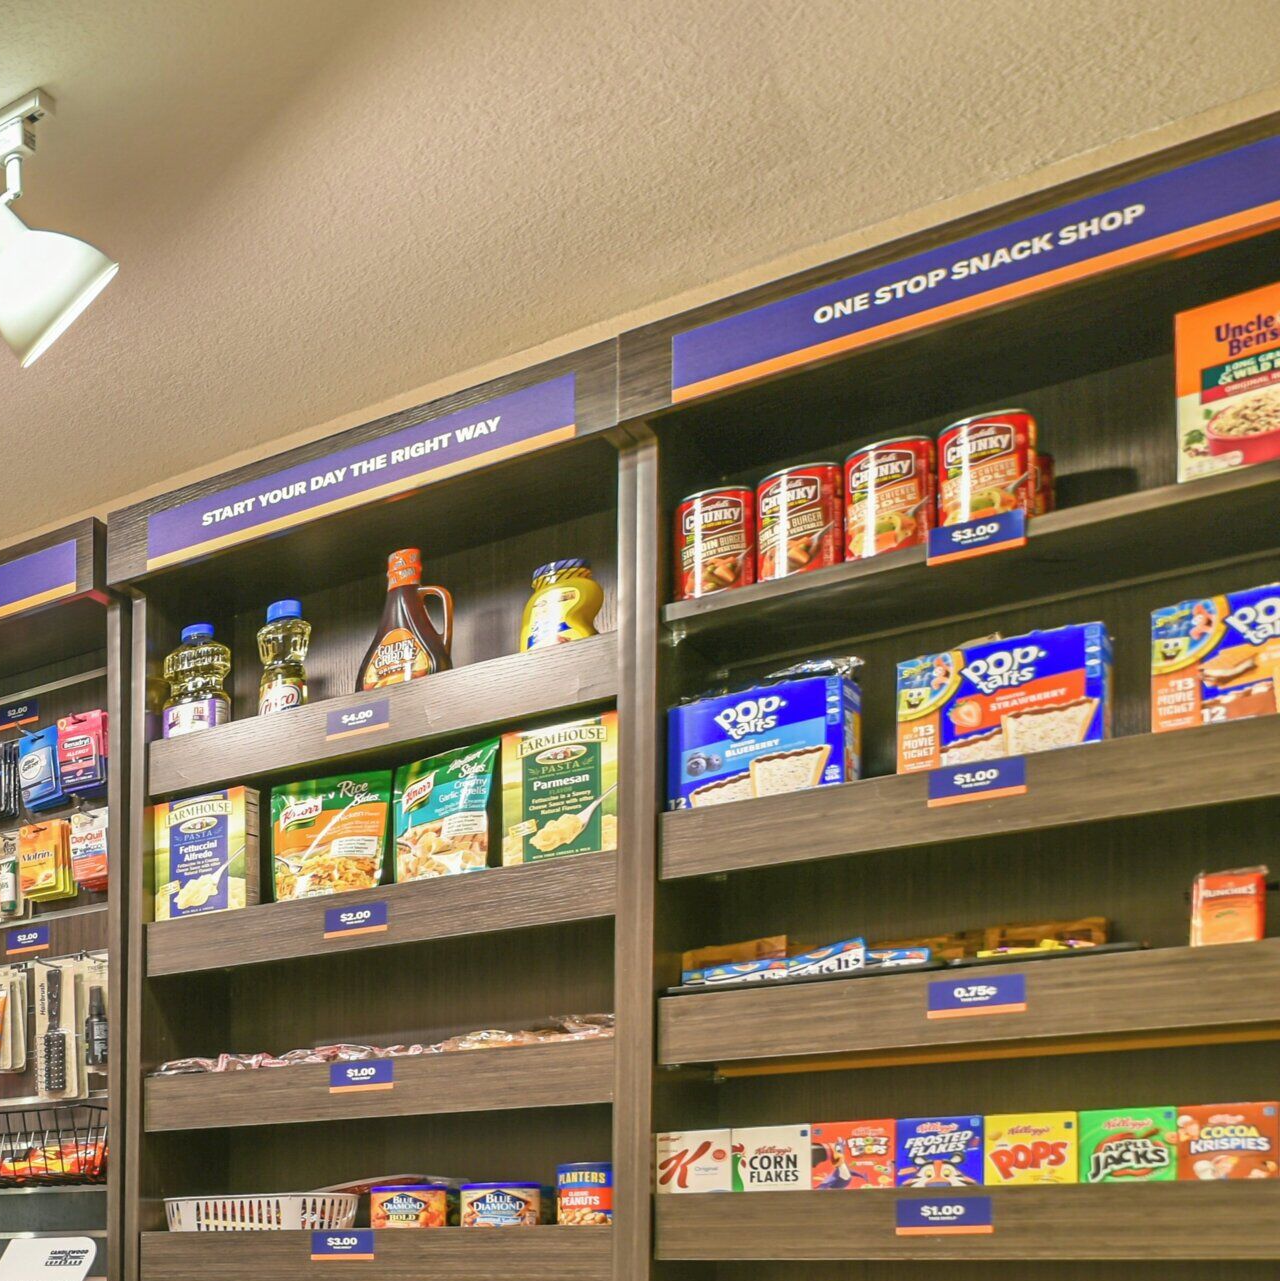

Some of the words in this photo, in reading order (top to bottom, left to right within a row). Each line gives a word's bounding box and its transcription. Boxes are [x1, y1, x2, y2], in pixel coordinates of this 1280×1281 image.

[813, 293, 870, 324] ONE
[874, 268, 947, 305] STOP
[951, 232, 1053, 279] SNACK
[1058, 204, 1145, 246] SHOP
[1215, 314, 1274, 342] Uncle
[202, 498, 255, 525] START
[259, 481, 307, 508] YOUR
[311, 467, 347, 490] DAY
[350, 455, 388, 478] THE
[391, 434, 450, 465] RIGHT
[456, 416, 500, 443] WAY
[792, 511, 822, 526] BURGER
[952, 523, 999, 542] $3.00
[377, 639, 416, 658] GOLDEN
[374, 647, 416, 670] GRIDDLE
[990, 687, 1067, 711] STRAWBERRY
[7, 706, 27, 716] $2.00
[341, 710, 373, 724] $4.00
[1201, 706, 1227, 723] 12
[63, 737, 91, 748] Benadryl
[520, 728, 605, 754] FARMHOUSE
[725, 739, 780, 757] BLUEBERRY
[903, 736, 935, 749] MOVIE
[903, 747, 935, 759] TICKET
[542, 761, 580, 774] PASTA
[534, 774, 589, 791] Parmesan
[953, 769, 999, 786] $1.00
[337, 781, 368, 798] Rice
[669, 798, 686, 810] 12
[167, 801, 231, 826] FARMHOUSE
[71, 830, 103, 844] DayQuil
[184, 830, 213, 842] PASTA
[22, 852, 50, 862] Motrin
[184, 850, 213, 863] Alfredo
[340, 911, 371, 923] $2.00
[17, 933, 38, 942] $2.00
[953, 986, 997, 999] 0.75¢
[346, 1067, 376, 1078] $1.00
[1199, 1125, 1259, 1139] COCOA
[848, 1136, 889, 1148] FROOT
[905, 1131, 973, 1149] FROSTED
[1103, 1140, 1151, 1153] APPLE
[1190, 1137, 1271, 1153] KRISPIES
[851, 1145, 887, 1156] LOOPS
[909, 1140, 966, 1157] FLAKES
[749, 1153, 798, 1170] CORN
[990, 1142, 1067, 1181] POPS
[1091, 1149, 1168, 1182] JACKS
[558, 1170, 607, 1186] PLANTERS
[750, 1170, 799, 1183] FLAKES
[473, 1201, 524, 1210] DIAMOND
[486, 1194, 512, 1203] BLUE
[562, 1196, 600, 1206] PEANUTS
[383, 1202, 425, 1210] DIAMOND
[921, 1205, 965, 1216] $1.00
[326, 1236, 358, 1247] $3.00
